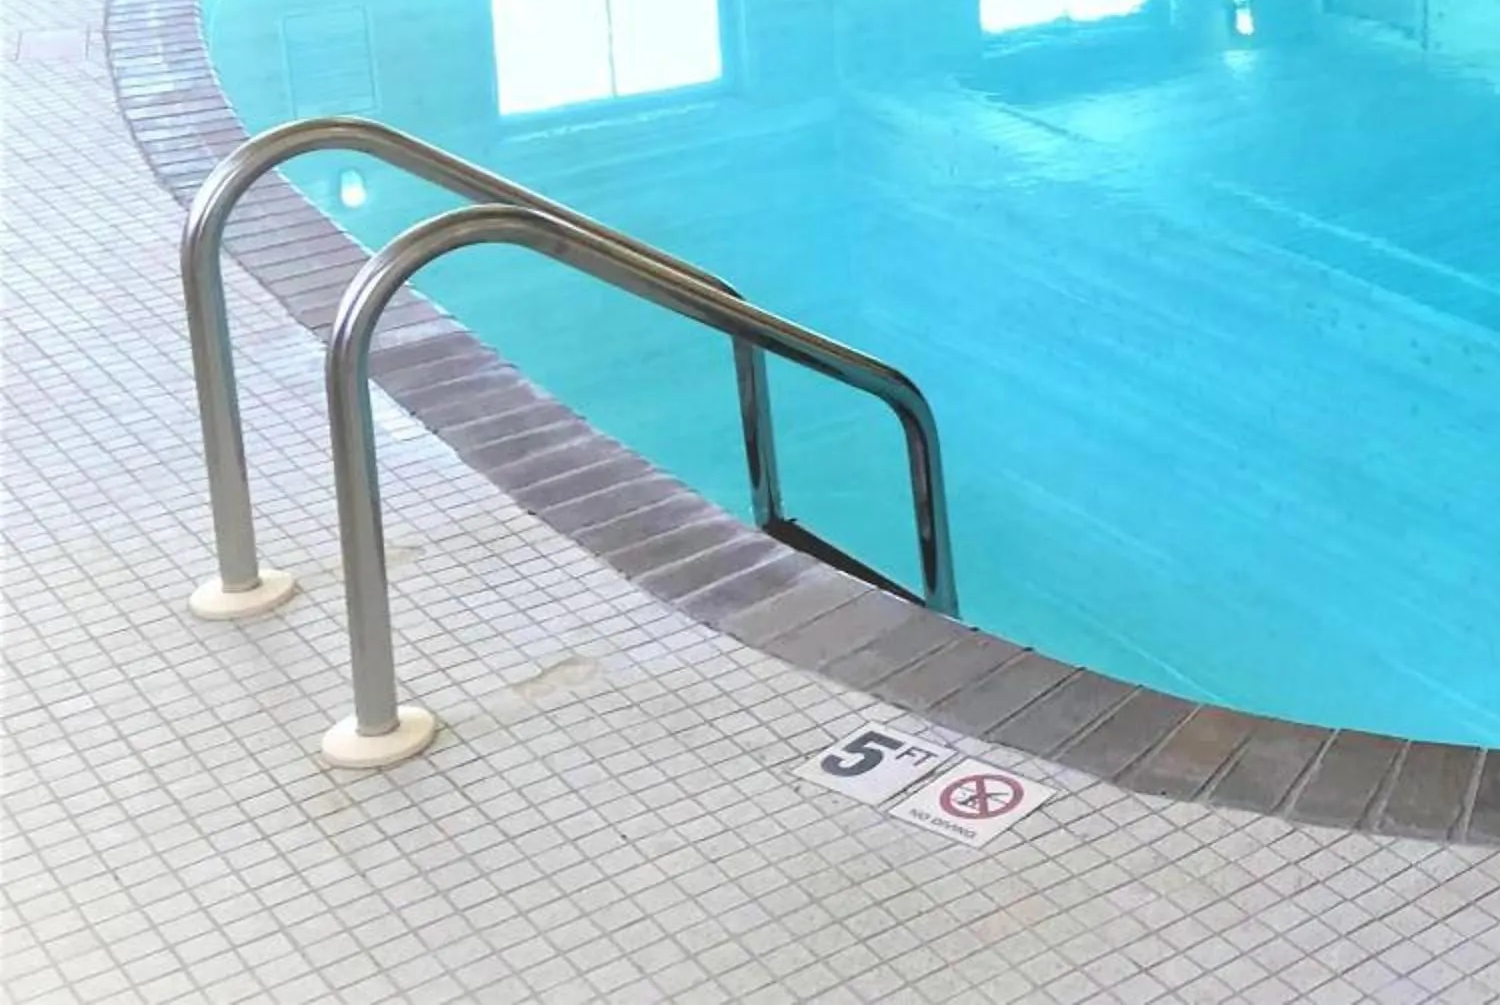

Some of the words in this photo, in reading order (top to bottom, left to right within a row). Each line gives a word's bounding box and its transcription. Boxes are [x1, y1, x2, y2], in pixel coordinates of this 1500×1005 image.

[820, 730, 905, 778] 5
[894, 744, 941, 767] FT
[909, 808, 931, 822] NO
